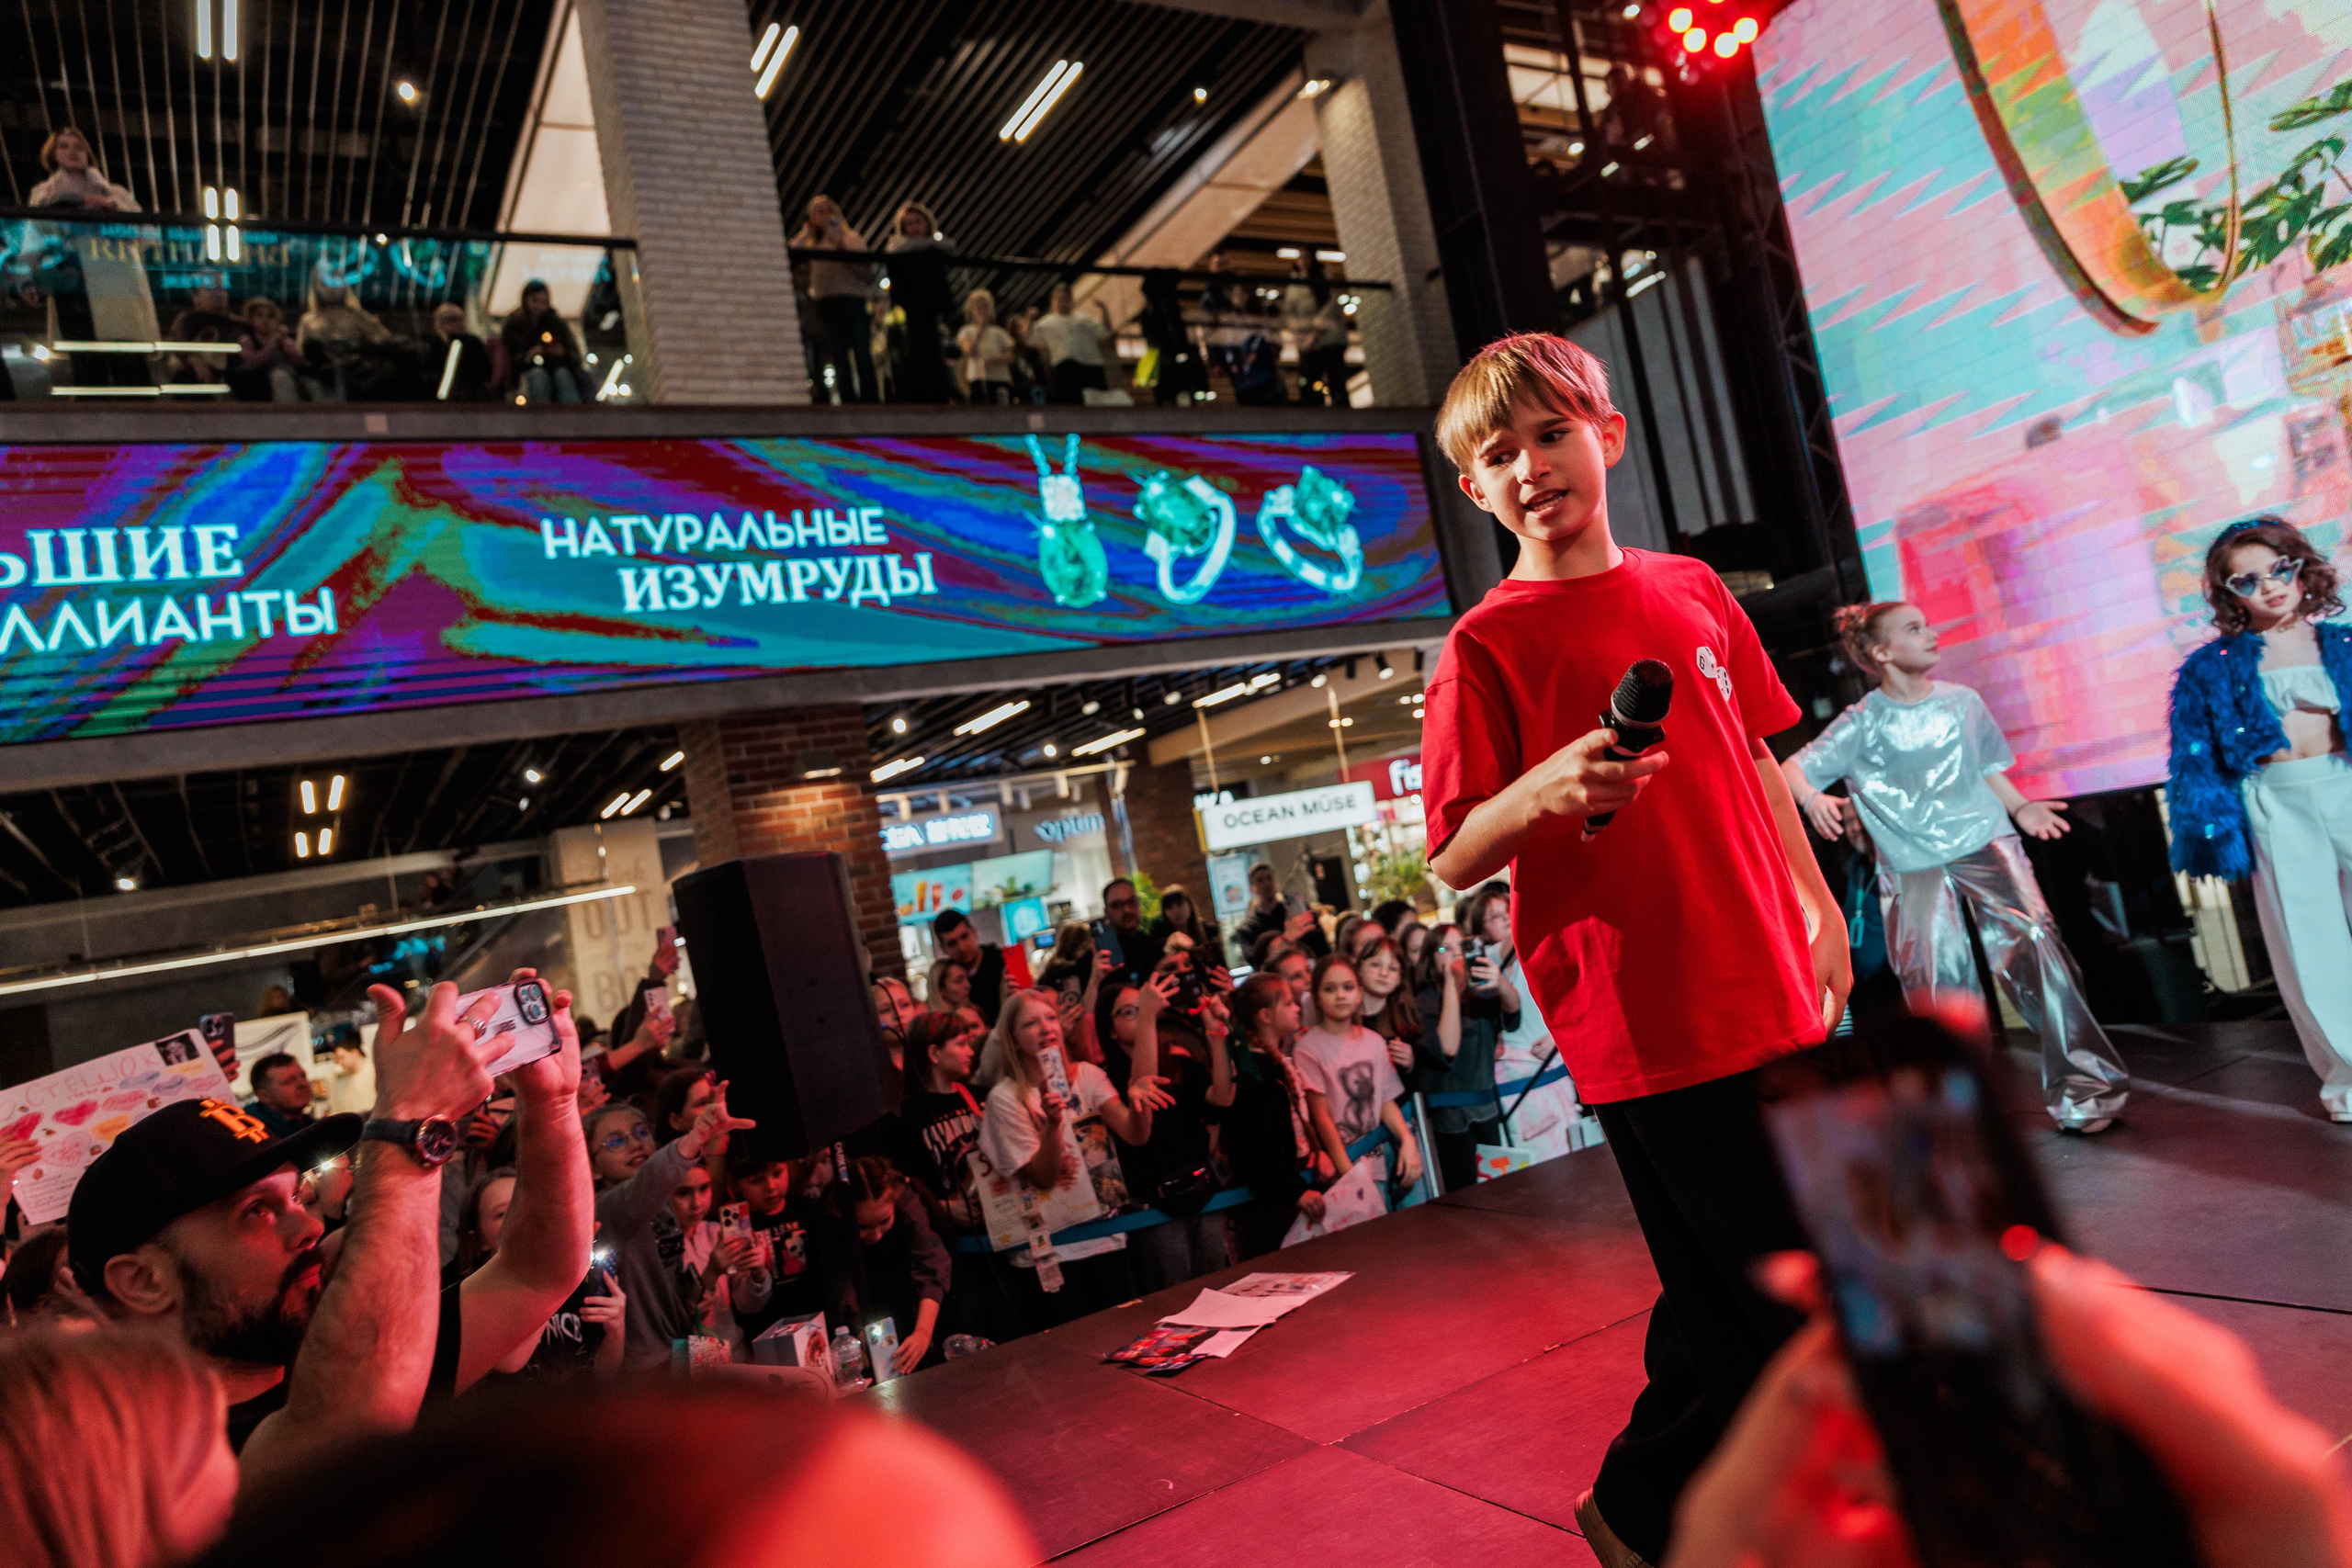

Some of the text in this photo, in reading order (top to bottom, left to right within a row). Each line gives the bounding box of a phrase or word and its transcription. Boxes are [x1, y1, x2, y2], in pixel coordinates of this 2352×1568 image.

[540, 505, 889, 559] НАТУРАЛЬНЫЕ
[616, 551, 939, 614] ИЗУМРУДЫ
[1223, 805, 1295, 829] OCEAN
